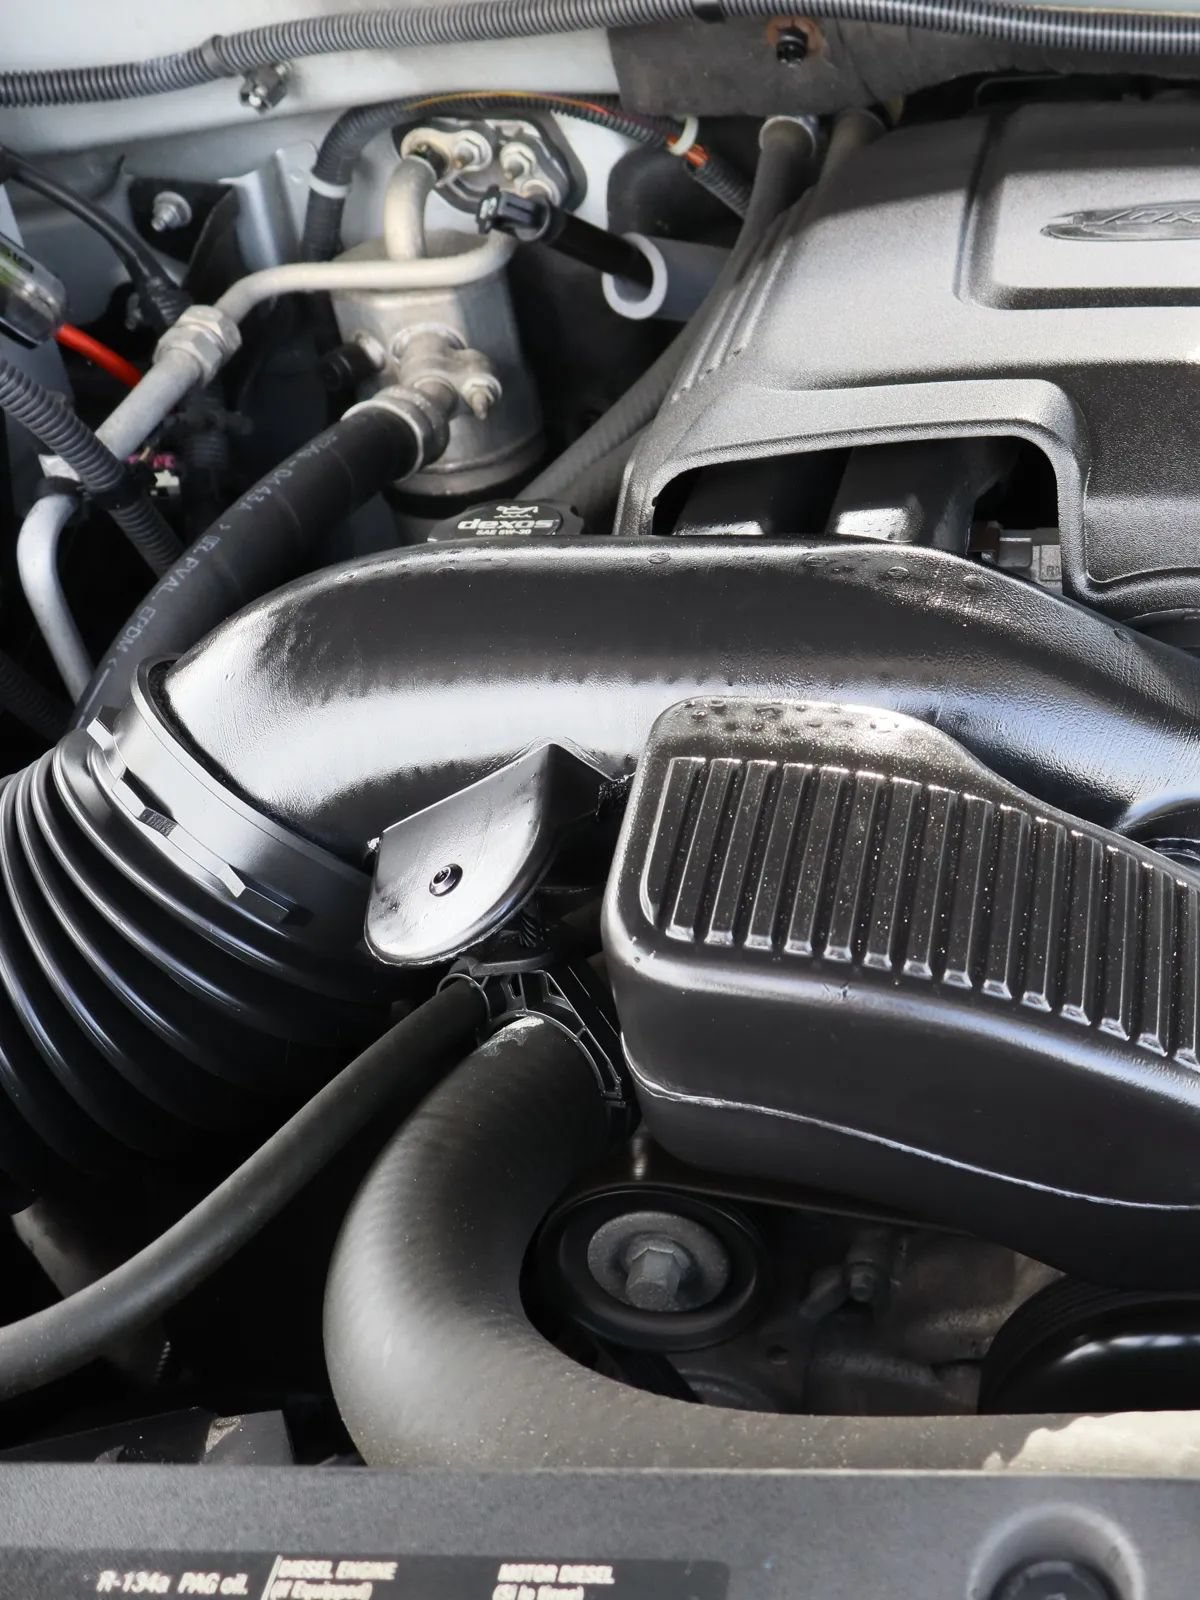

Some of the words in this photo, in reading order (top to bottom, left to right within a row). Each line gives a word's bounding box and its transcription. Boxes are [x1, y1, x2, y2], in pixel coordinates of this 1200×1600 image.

[457, 518, 555, 530] dexos
[335, 1561, 399, 1580] ENGINE
[497, 1563, 558, 1583] MOTOR
